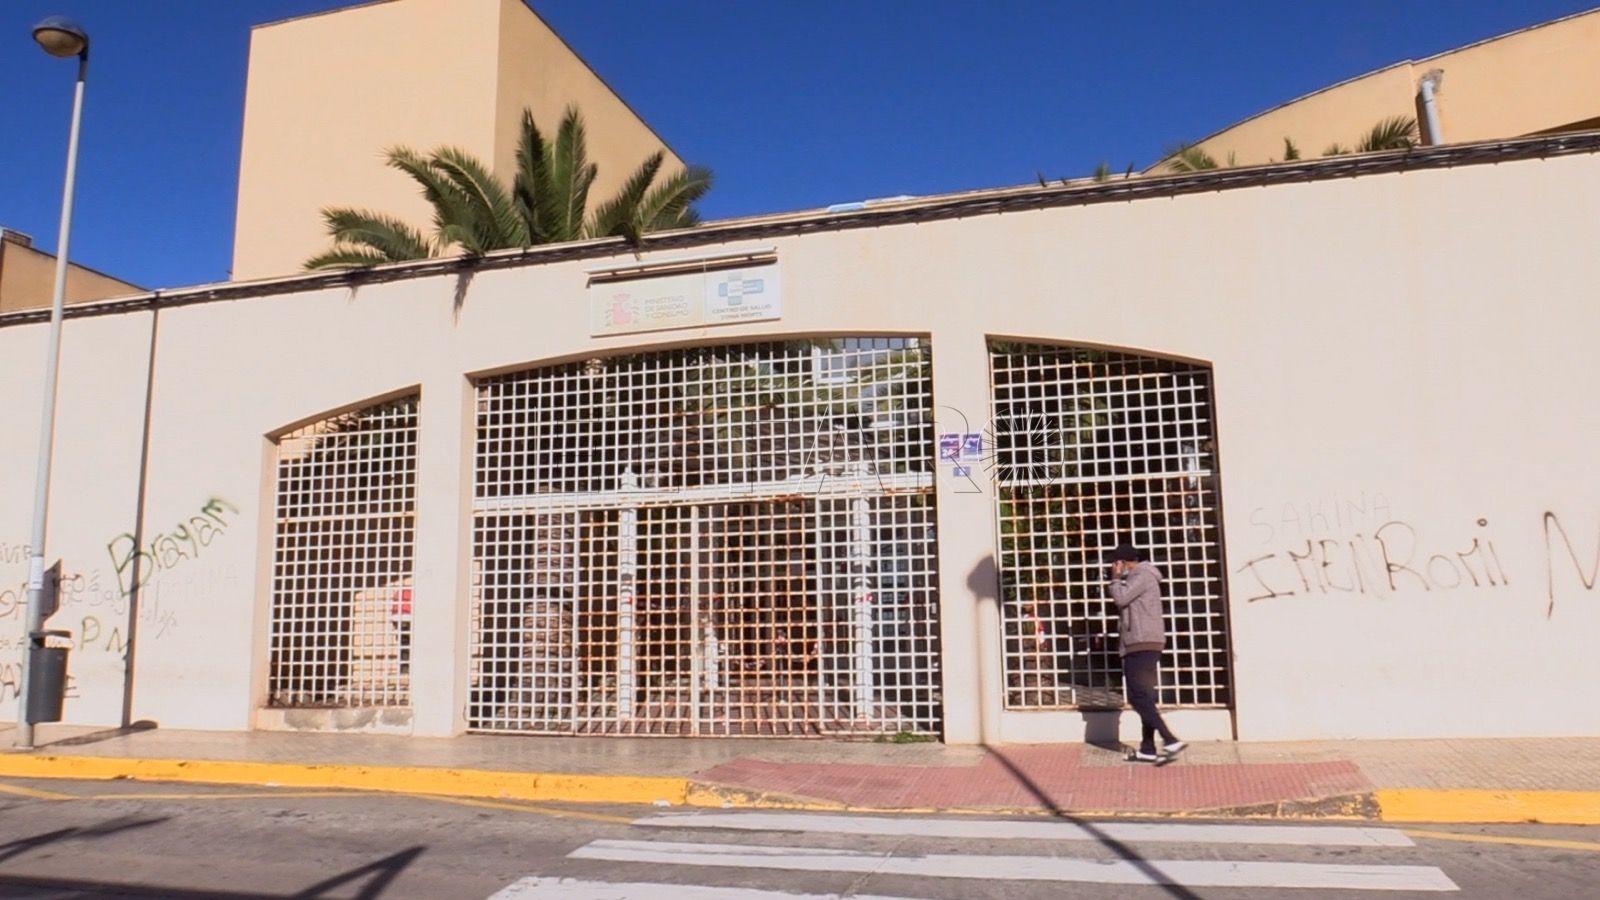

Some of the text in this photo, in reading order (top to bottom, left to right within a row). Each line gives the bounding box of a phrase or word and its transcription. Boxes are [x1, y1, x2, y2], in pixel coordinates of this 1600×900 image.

[645, 296, 684, 304] MINISTERIO
[645, 303, 688, 312] DE SANIDAD
[652, 309, 689, 319] CONSUMO
